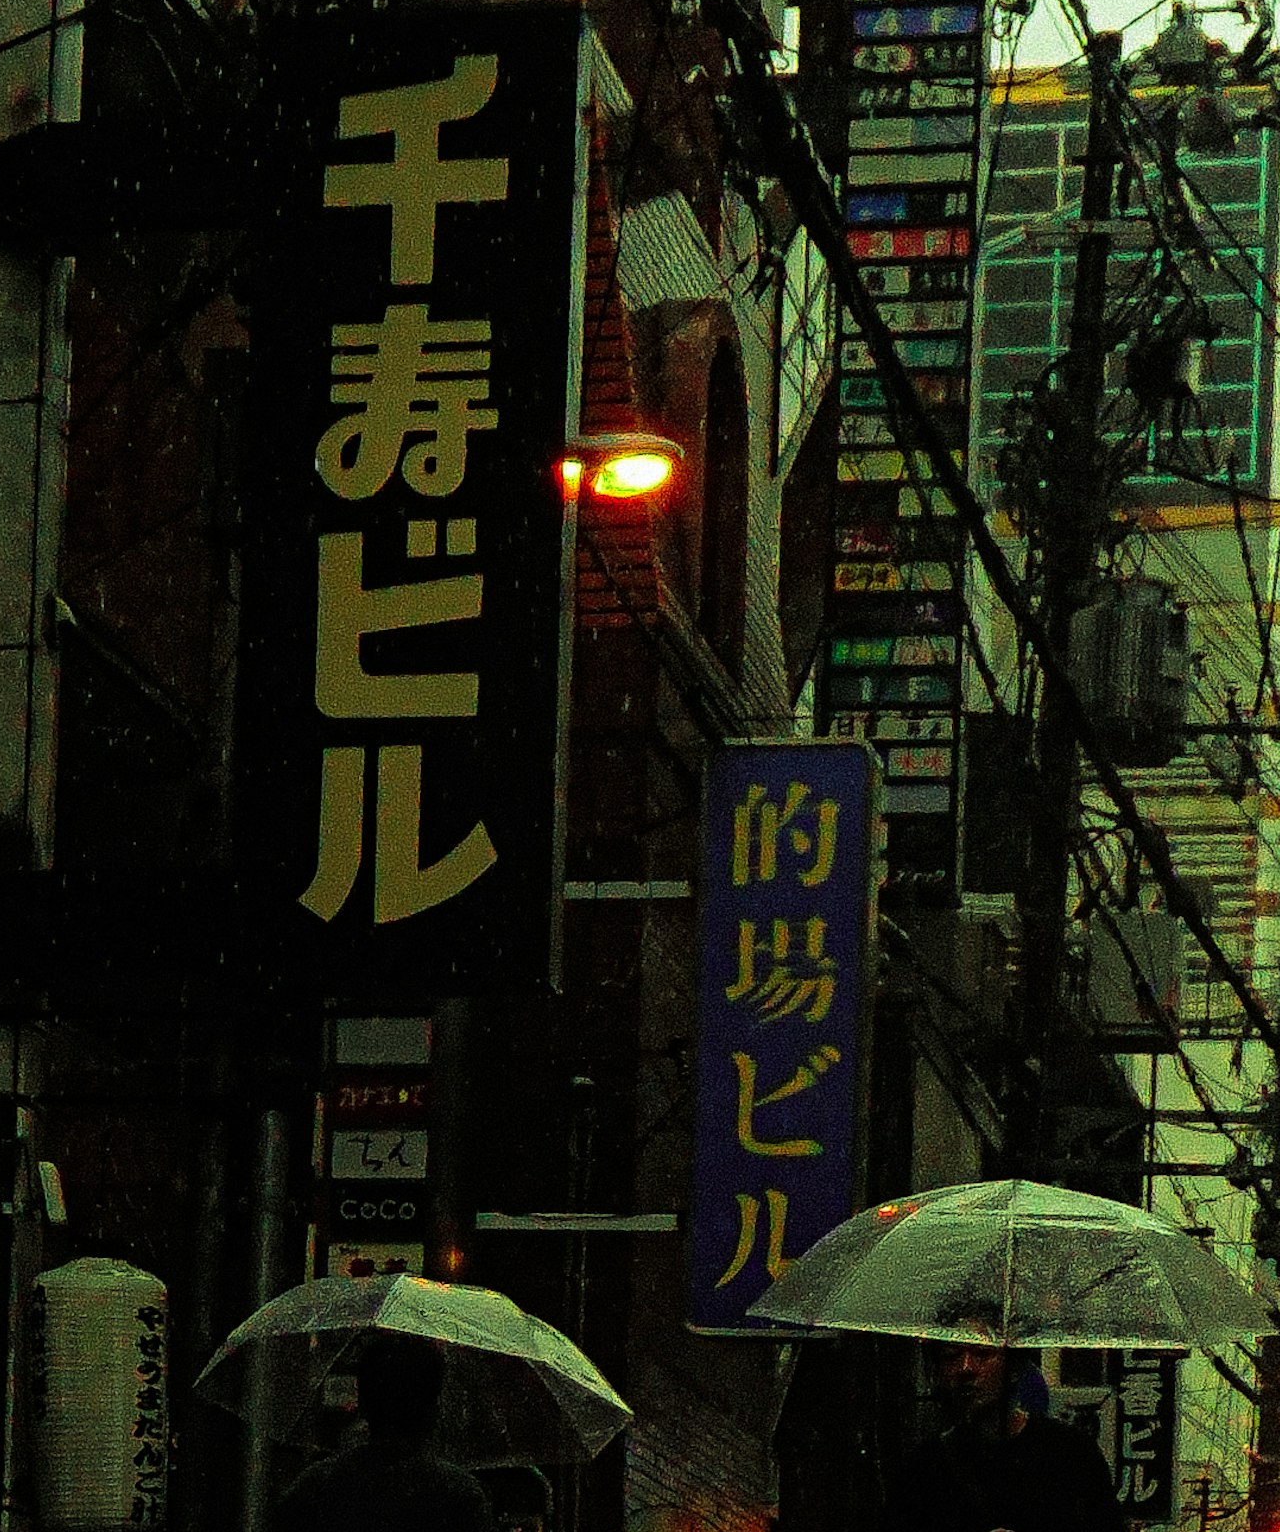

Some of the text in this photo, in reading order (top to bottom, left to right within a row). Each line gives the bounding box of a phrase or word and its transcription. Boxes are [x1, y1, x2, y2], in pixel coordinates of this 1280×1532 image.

[298, 53, 510, 926] 千寿ビル
[715, 781, 841, 1290] 的場ビル
[130, 1304, 163, 1524] やせうまだんご汁
